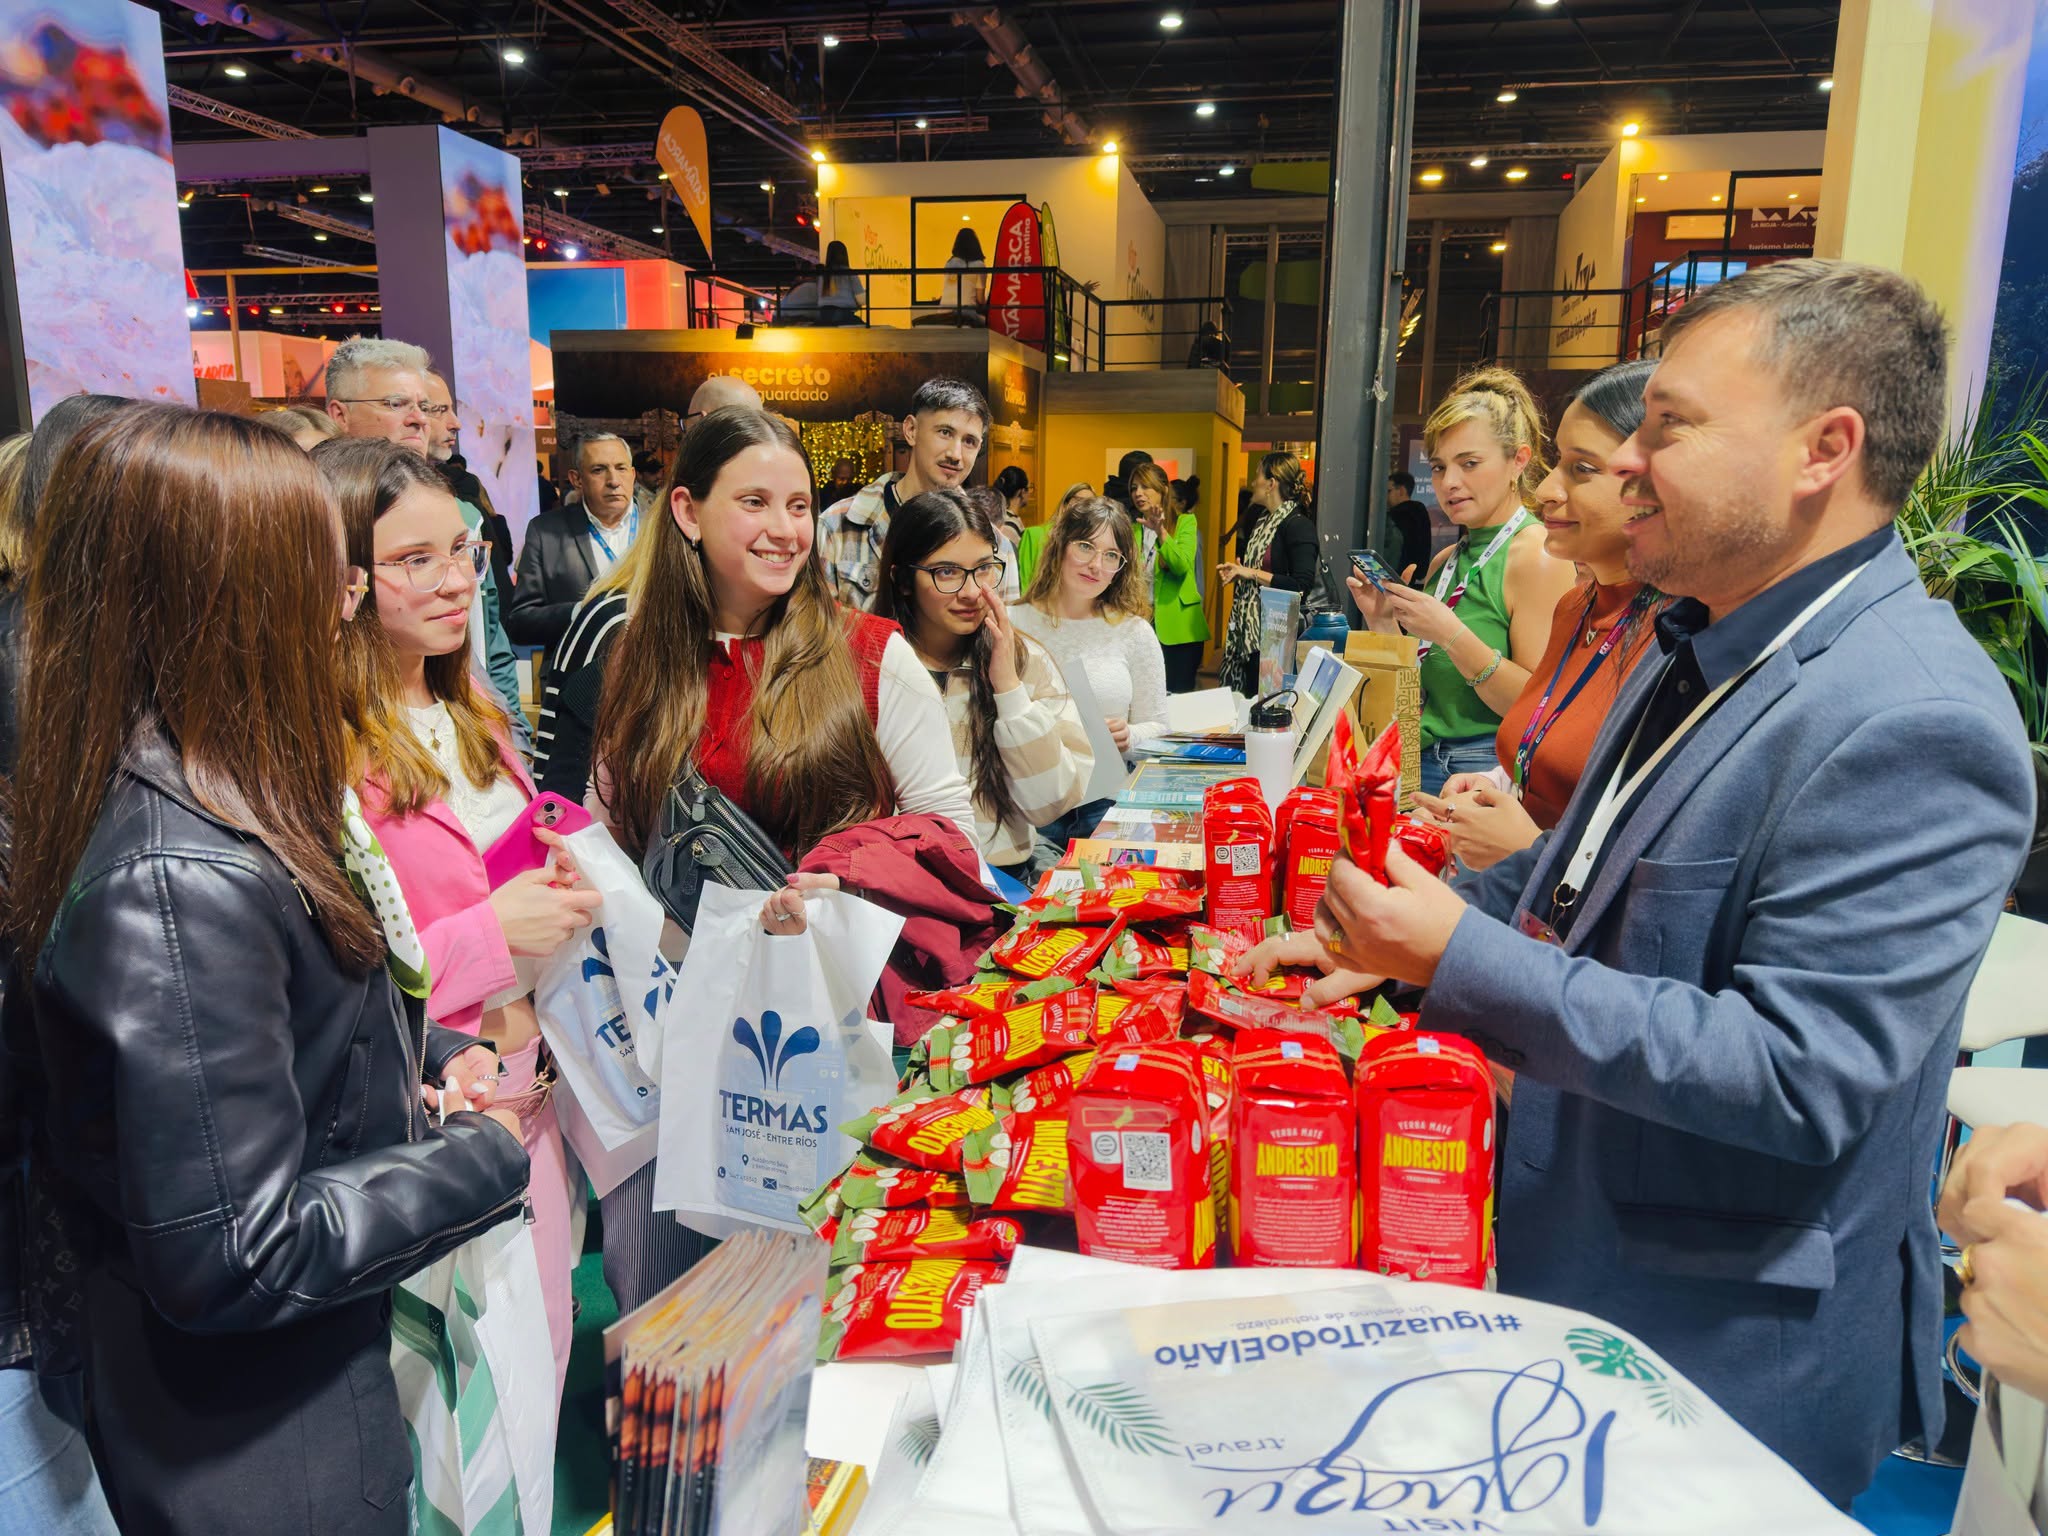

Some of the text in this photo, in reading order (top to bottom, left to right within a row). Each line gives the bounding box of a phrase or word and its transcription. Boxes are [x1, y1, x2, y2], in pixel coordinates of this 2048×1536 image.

[729, 363, 831, 386] secreto
[719, 1089, 828, 1134] TERMAS
[725, 1124, 740, 1134] SAN
[741, 1128, 761, 1140] JOSÉ
[767, 1133, 793, 1146] ENTRE
[796, 1136, 817, 1148] RÍOS
[1428, 1122, 1453, 1135] MATE
[1256, 1142, 1338, 1178] ANDRESITO
[1382, 1133, 1467, 1174] ANDRESITO
[1324, 1310, 1344, 1321] de
[1155, 1310, 1522, 1369] #IguazúTodoElAño
[1184, 1438, 1284, 1460] .travel
[1383, 1518, 1503, 1533] VISIT
